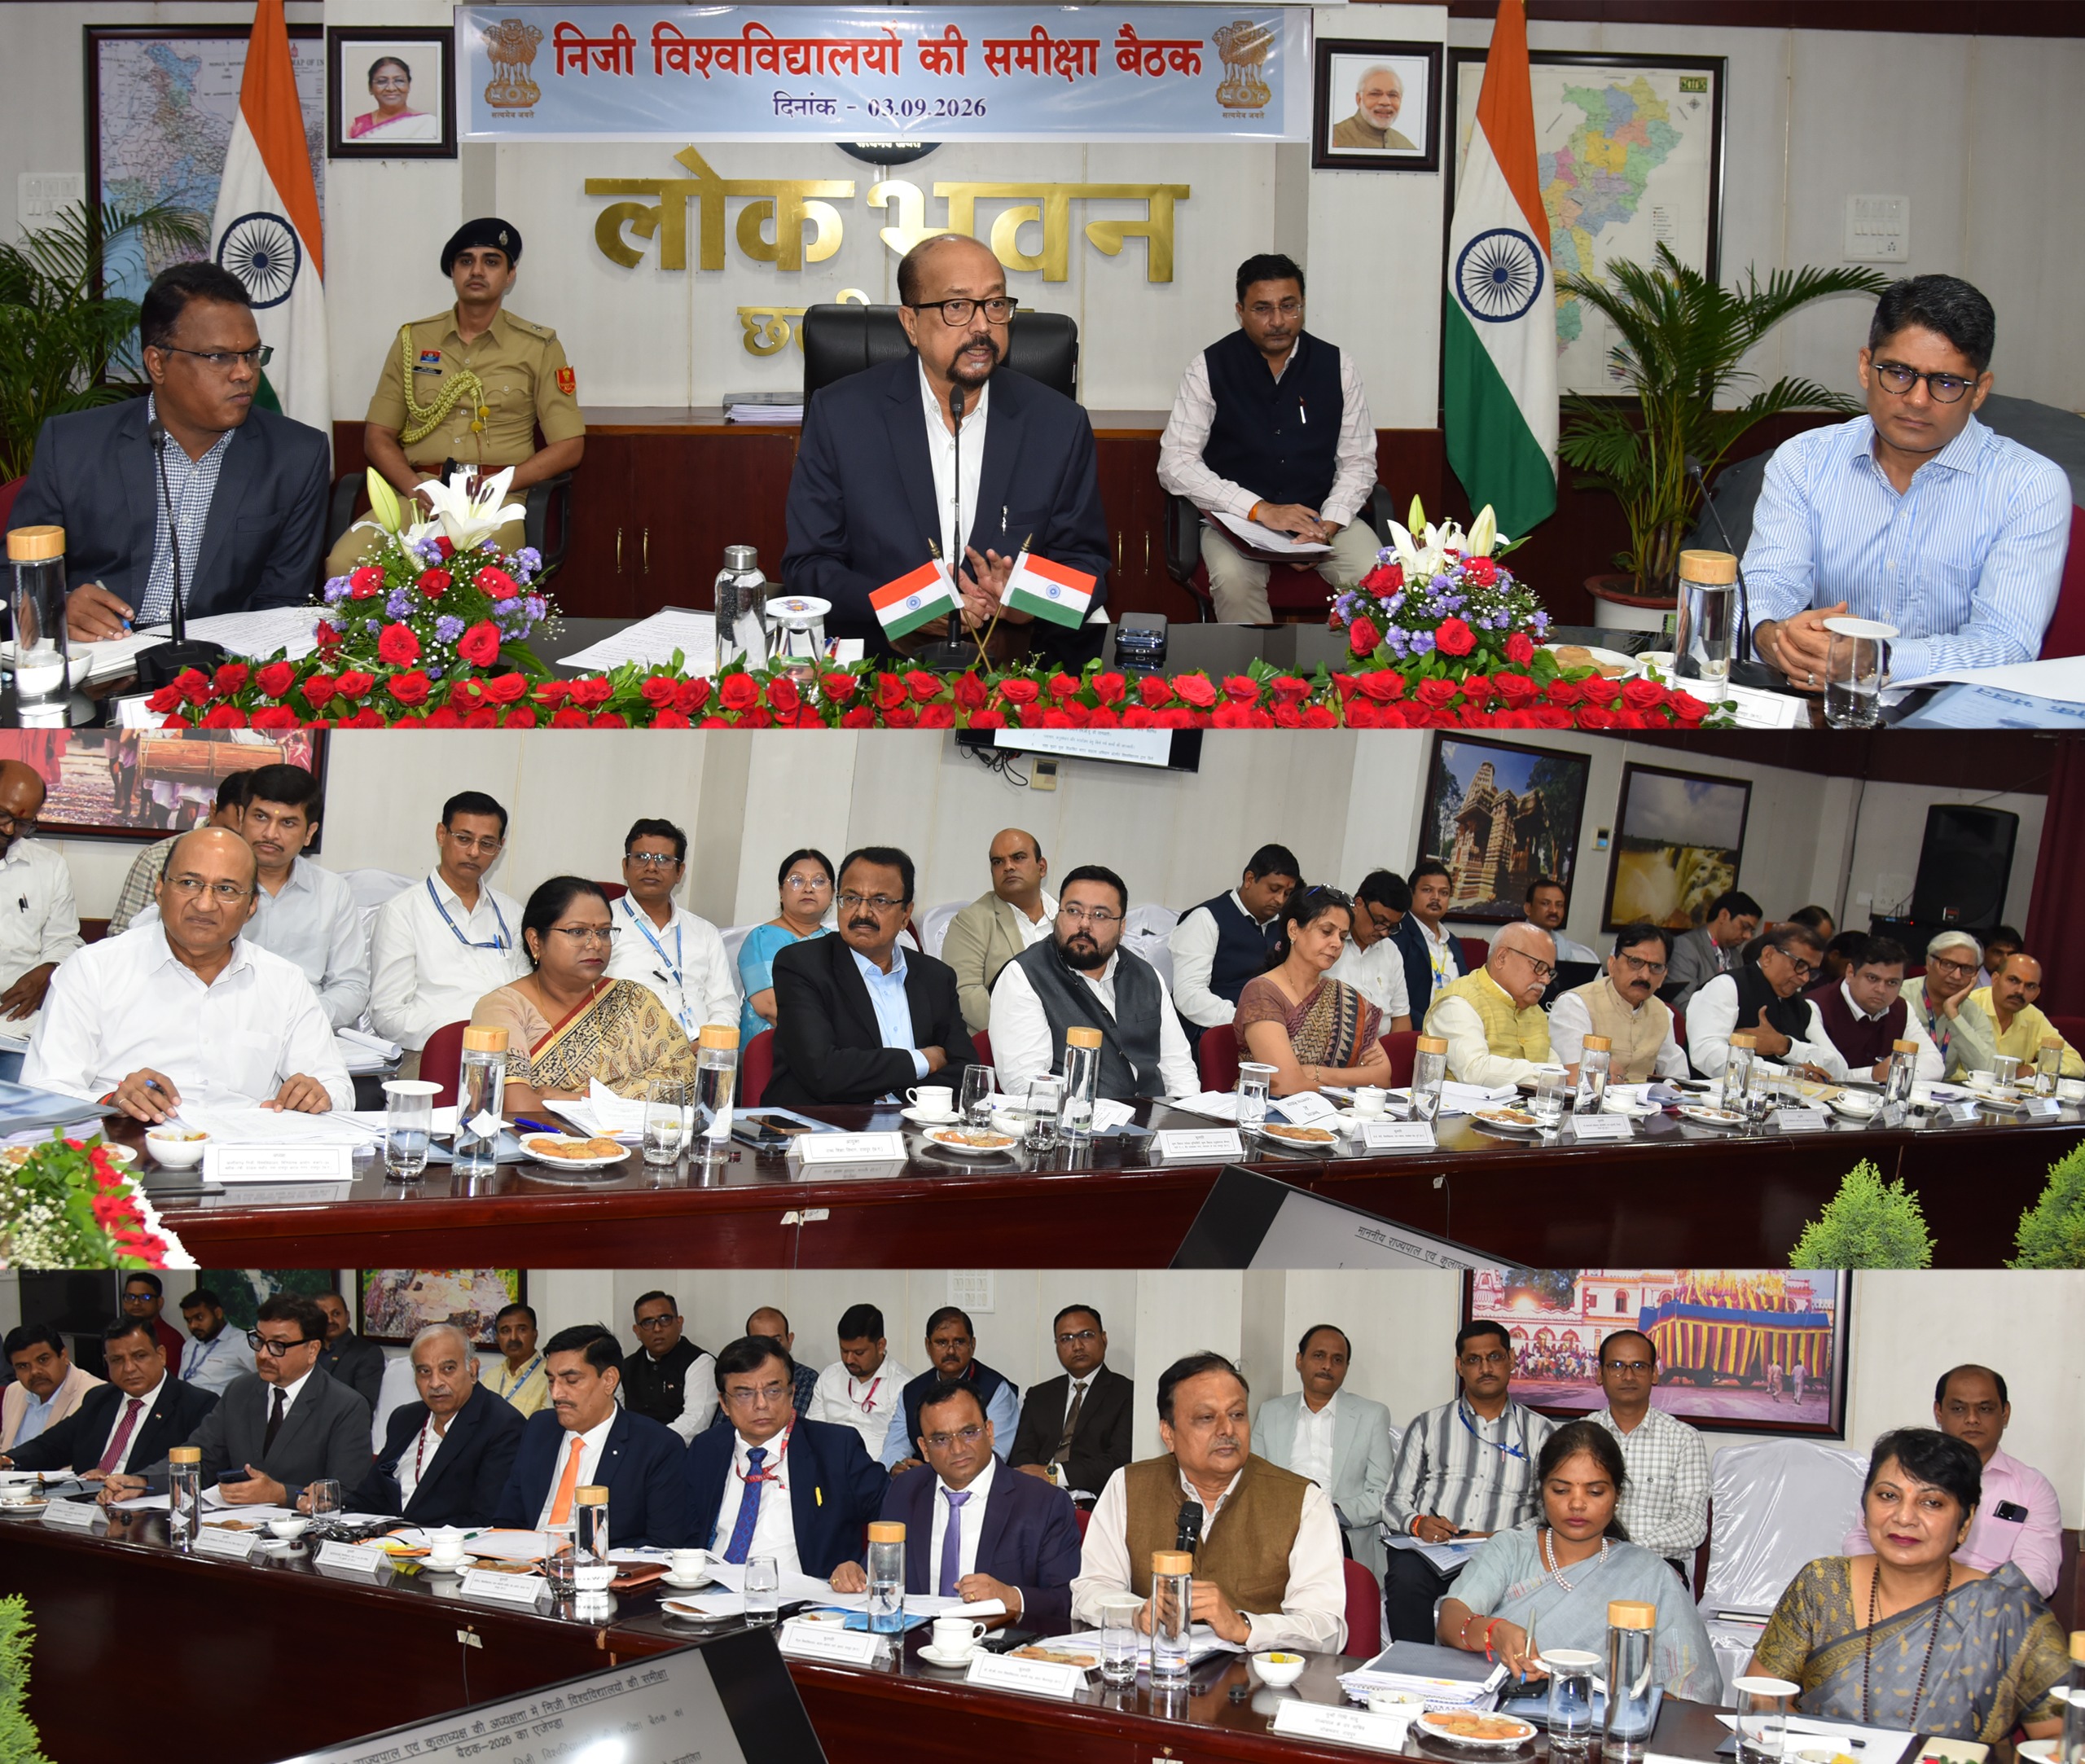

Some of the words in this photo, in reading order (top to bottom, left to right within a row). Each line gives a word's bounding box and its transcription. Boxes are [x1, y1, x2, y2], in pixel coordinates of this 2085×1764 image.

[553, 20, 636, 77] निजी
[917, 24, 968, 77] की
[982, 24, 1100, 82] समीक्षा
[1114, 22, 1203, 77] बैठक
[772, 90, 837, 118] दिनांक
[867, 98, 986, 117] 03.09.2026
[585, 145, 855, 271] लोक
[867, 178, 1190, 282] भवन
[1357, 1226, 1385, 1244] माननीय
[1389, 1237, 1422, 1257] राज्यपाल
[1424, 1250, 1438, 1261] एवं
[404, 1739, 420, 1757] एवं
[424, 1727, 468, 1750] कुलाध्यक्ष
[470, 1720, 486, 1735] की
[489, 1709, 528, 1729] अध्यक्षता
[531, 1705, 540, 1718] में
[541, 1698, 565, 1714] निजी
[626, 1674, 639, 1688] की
[515, 1729, 529, 1741] का
